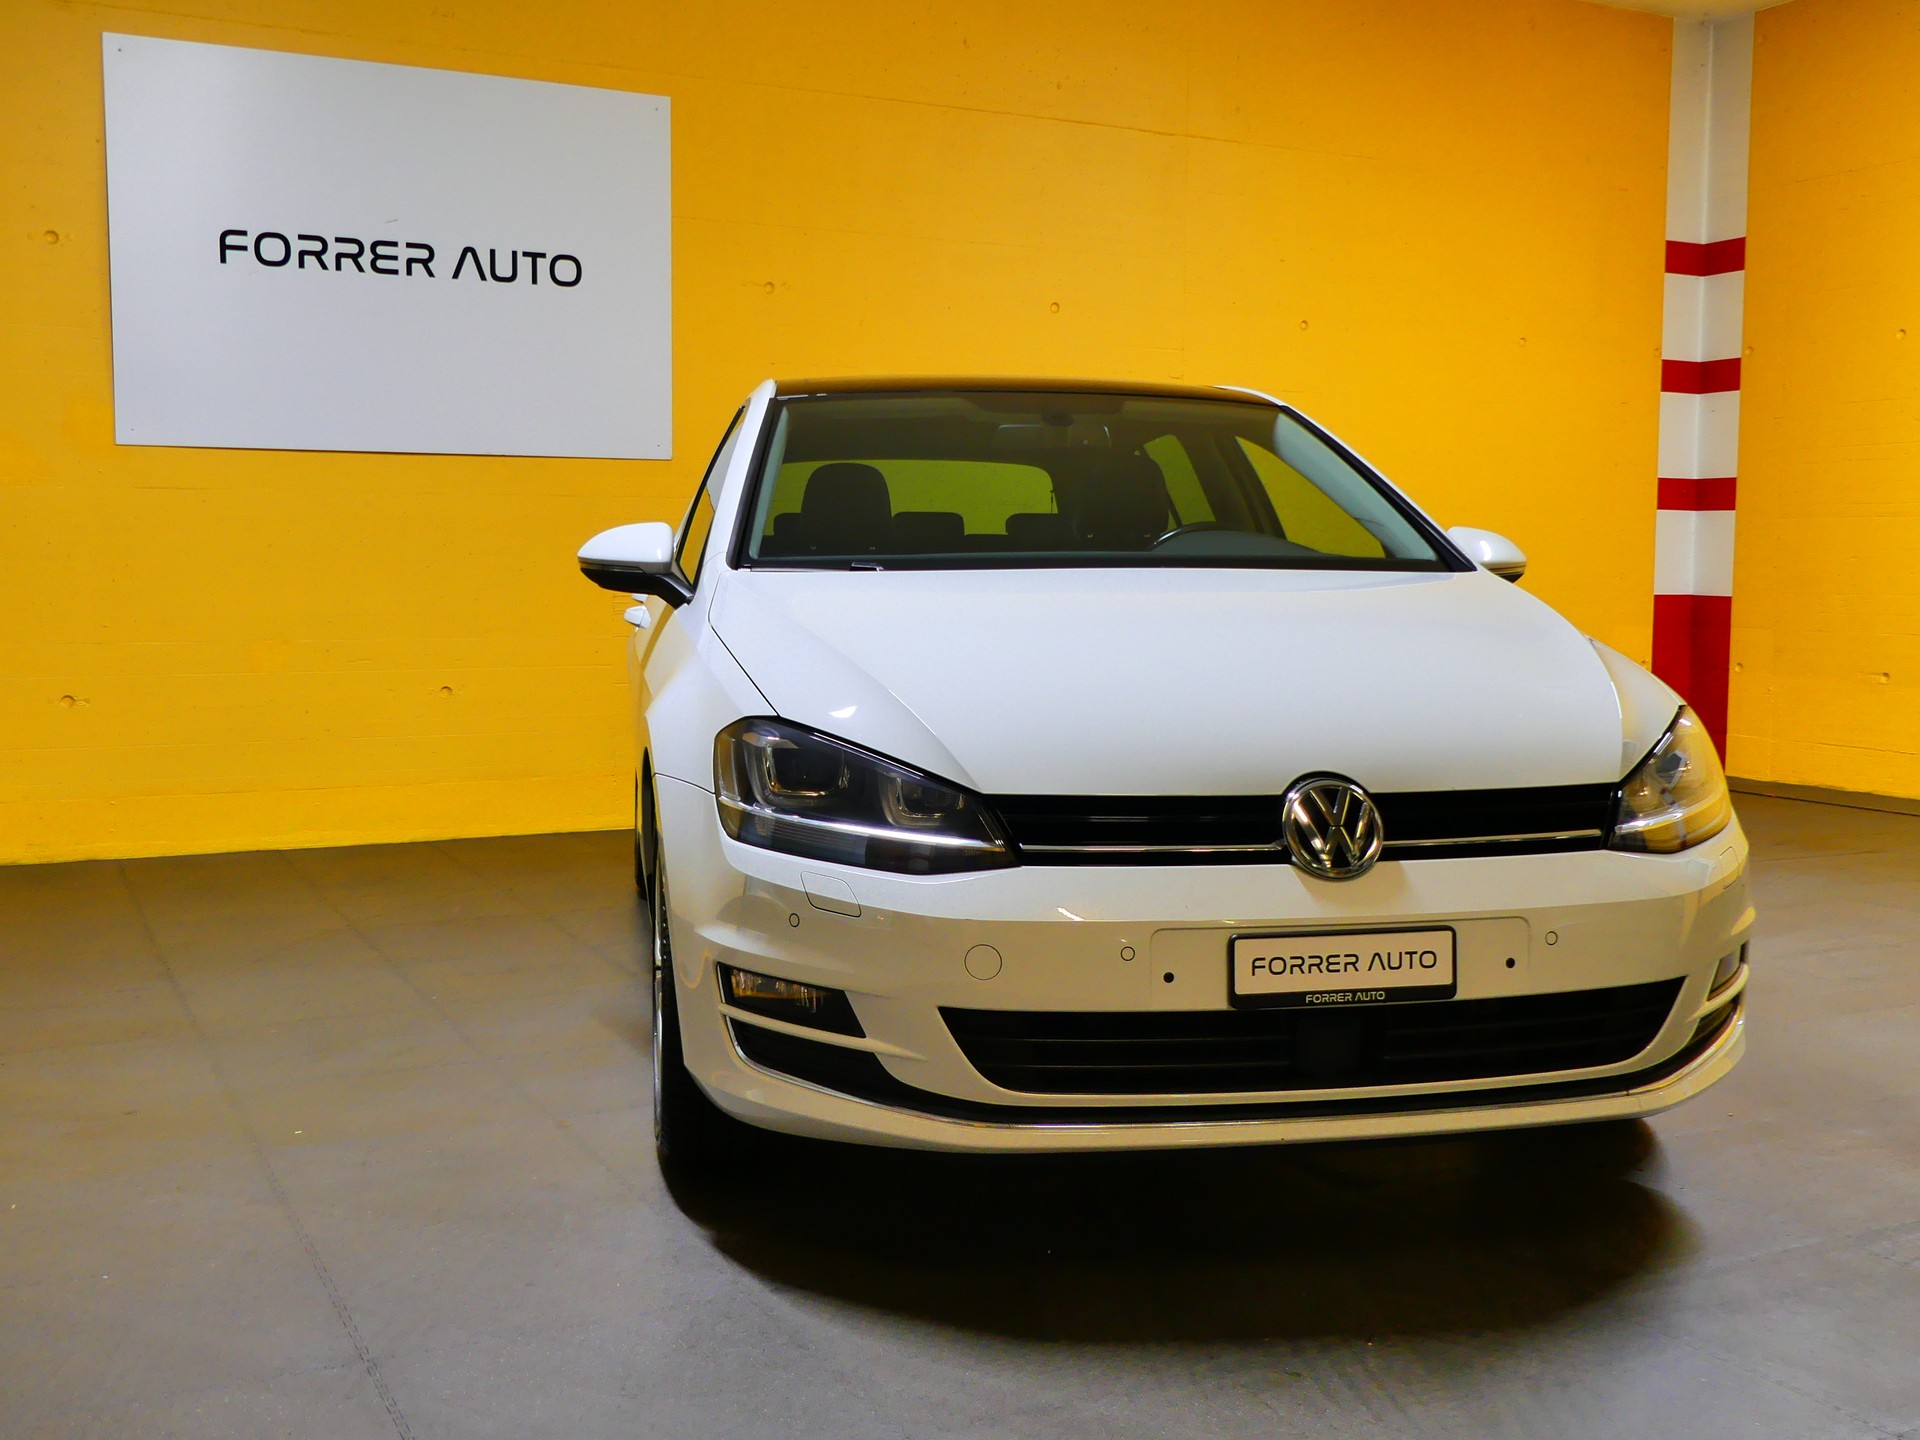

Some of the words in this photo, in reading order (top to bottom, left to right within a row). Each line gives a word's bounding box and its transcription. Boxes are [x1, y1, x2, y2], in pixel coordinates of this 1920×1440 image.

[219, 229, 436, 279] FORRER
[451, 245, 583, 288] AUTO
[1251, 953, 1360, 977] FORRER
[1367, 950, 1438, 972] AUTO
[1305, 992, 1353, 1004] FORRER
[1354, 990, 1386, 1001] AUTO
